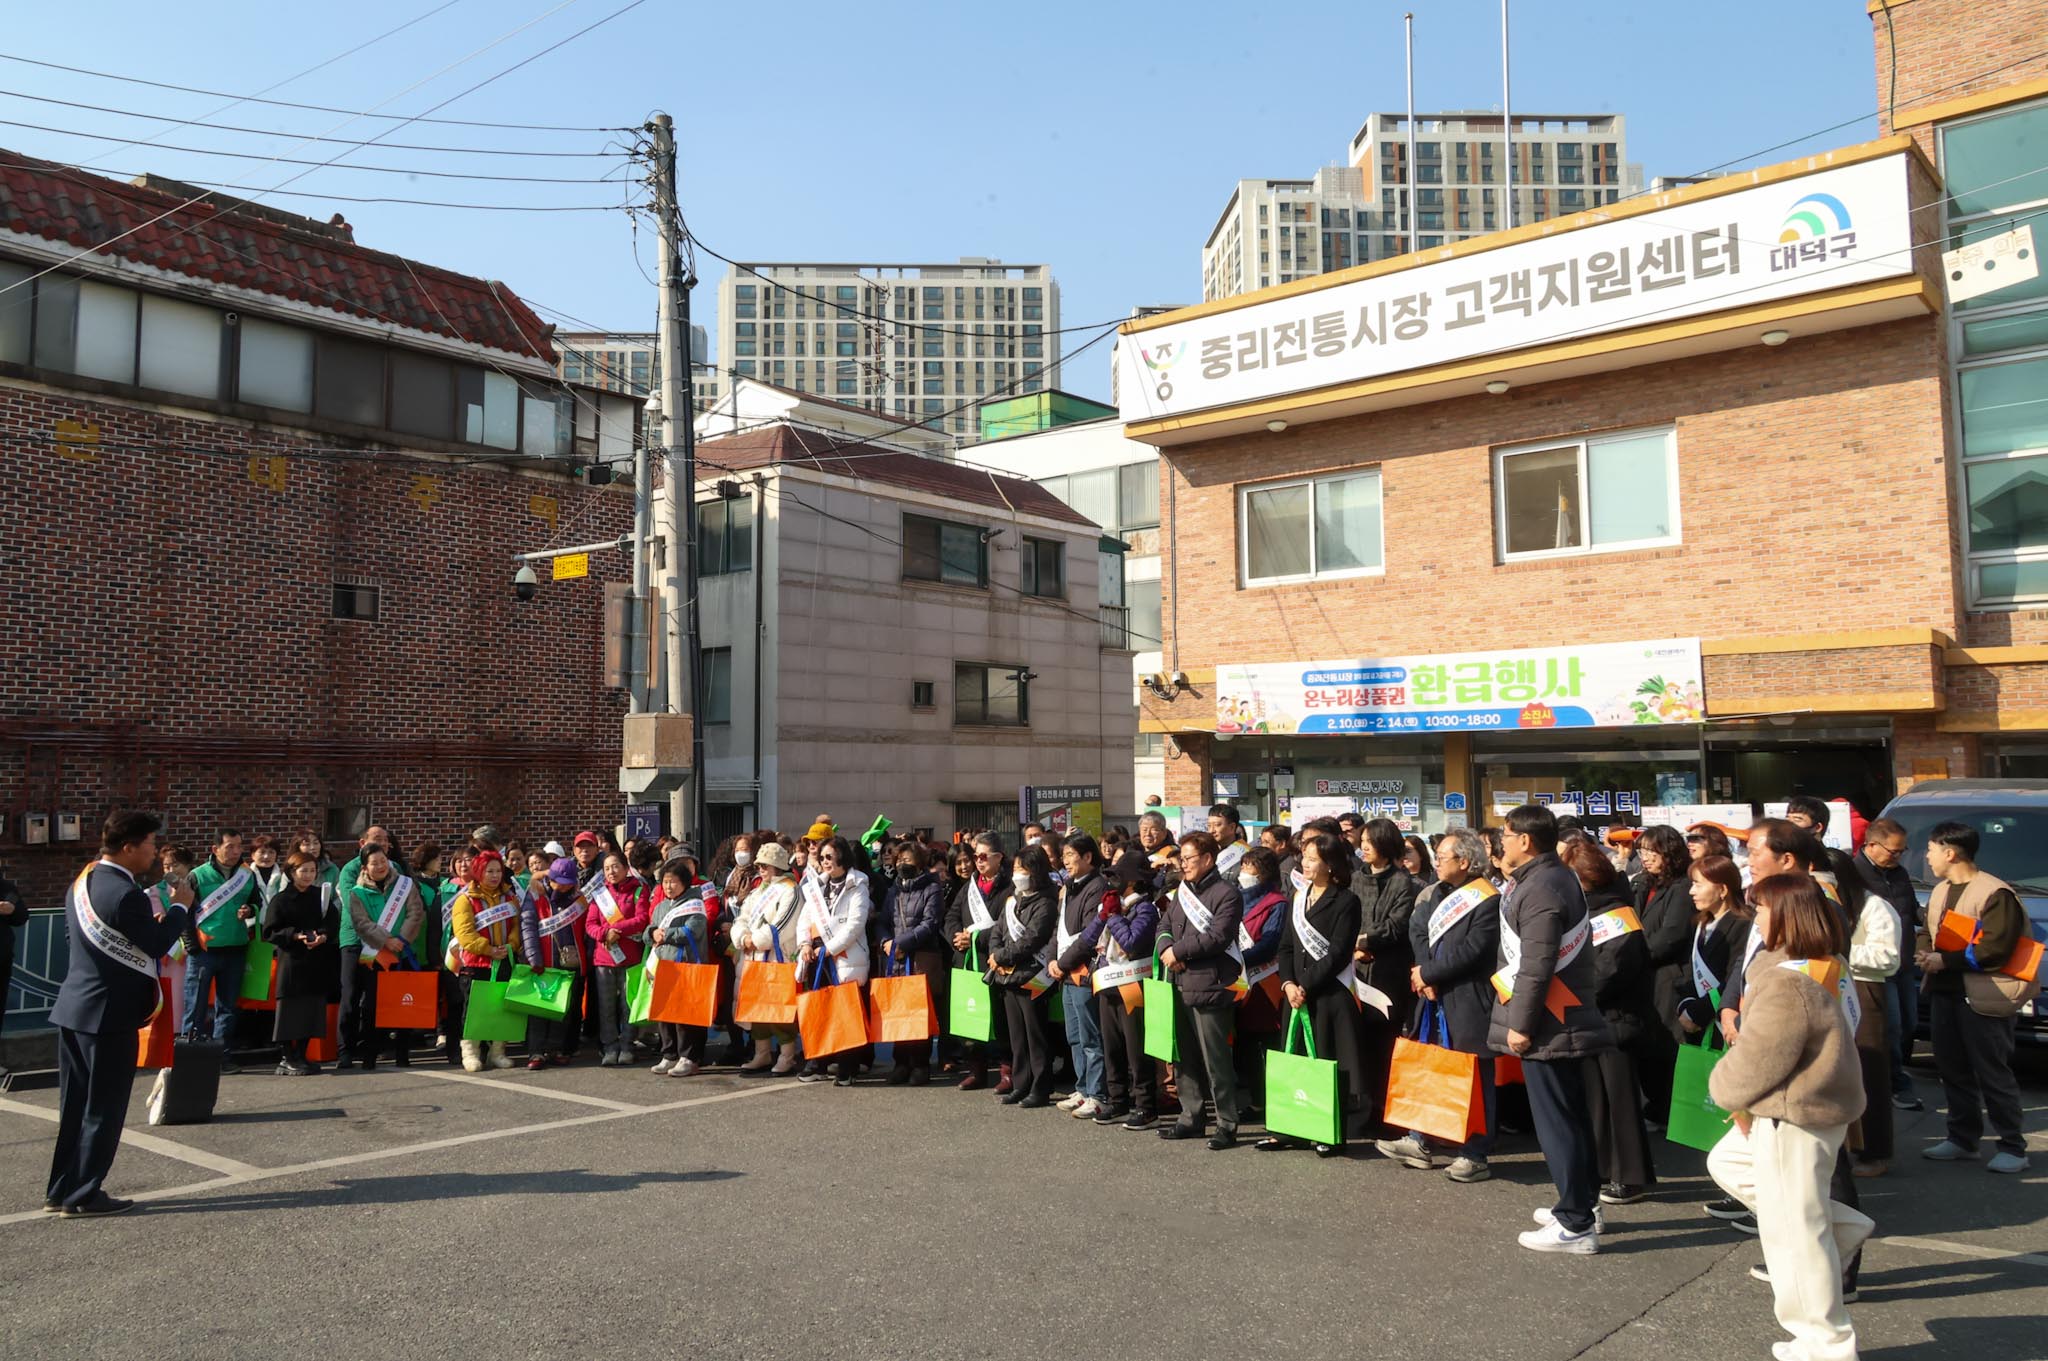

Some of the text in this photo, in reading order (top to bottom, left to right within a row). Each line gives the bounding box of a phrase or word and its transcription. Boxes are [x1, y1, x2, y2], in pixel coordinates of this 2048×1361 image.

[1770, 231, 1857, 273] 대덕구
[1200, 223, 1740, 380] 중리전통시장 고객지원센터
[1410, 656, 1586, 706] 환급행사
[1304, 687, 1405, 708] 온누리상품권
[1521, 709, 1552, 720] 소진시
[1339, 779, 1404, 793] 중리전통시장
[1448, 800, 1462, 810] 26
[1534, 790, 1641, 817] 고객쉼터
[636, 817, 644, 836] P
